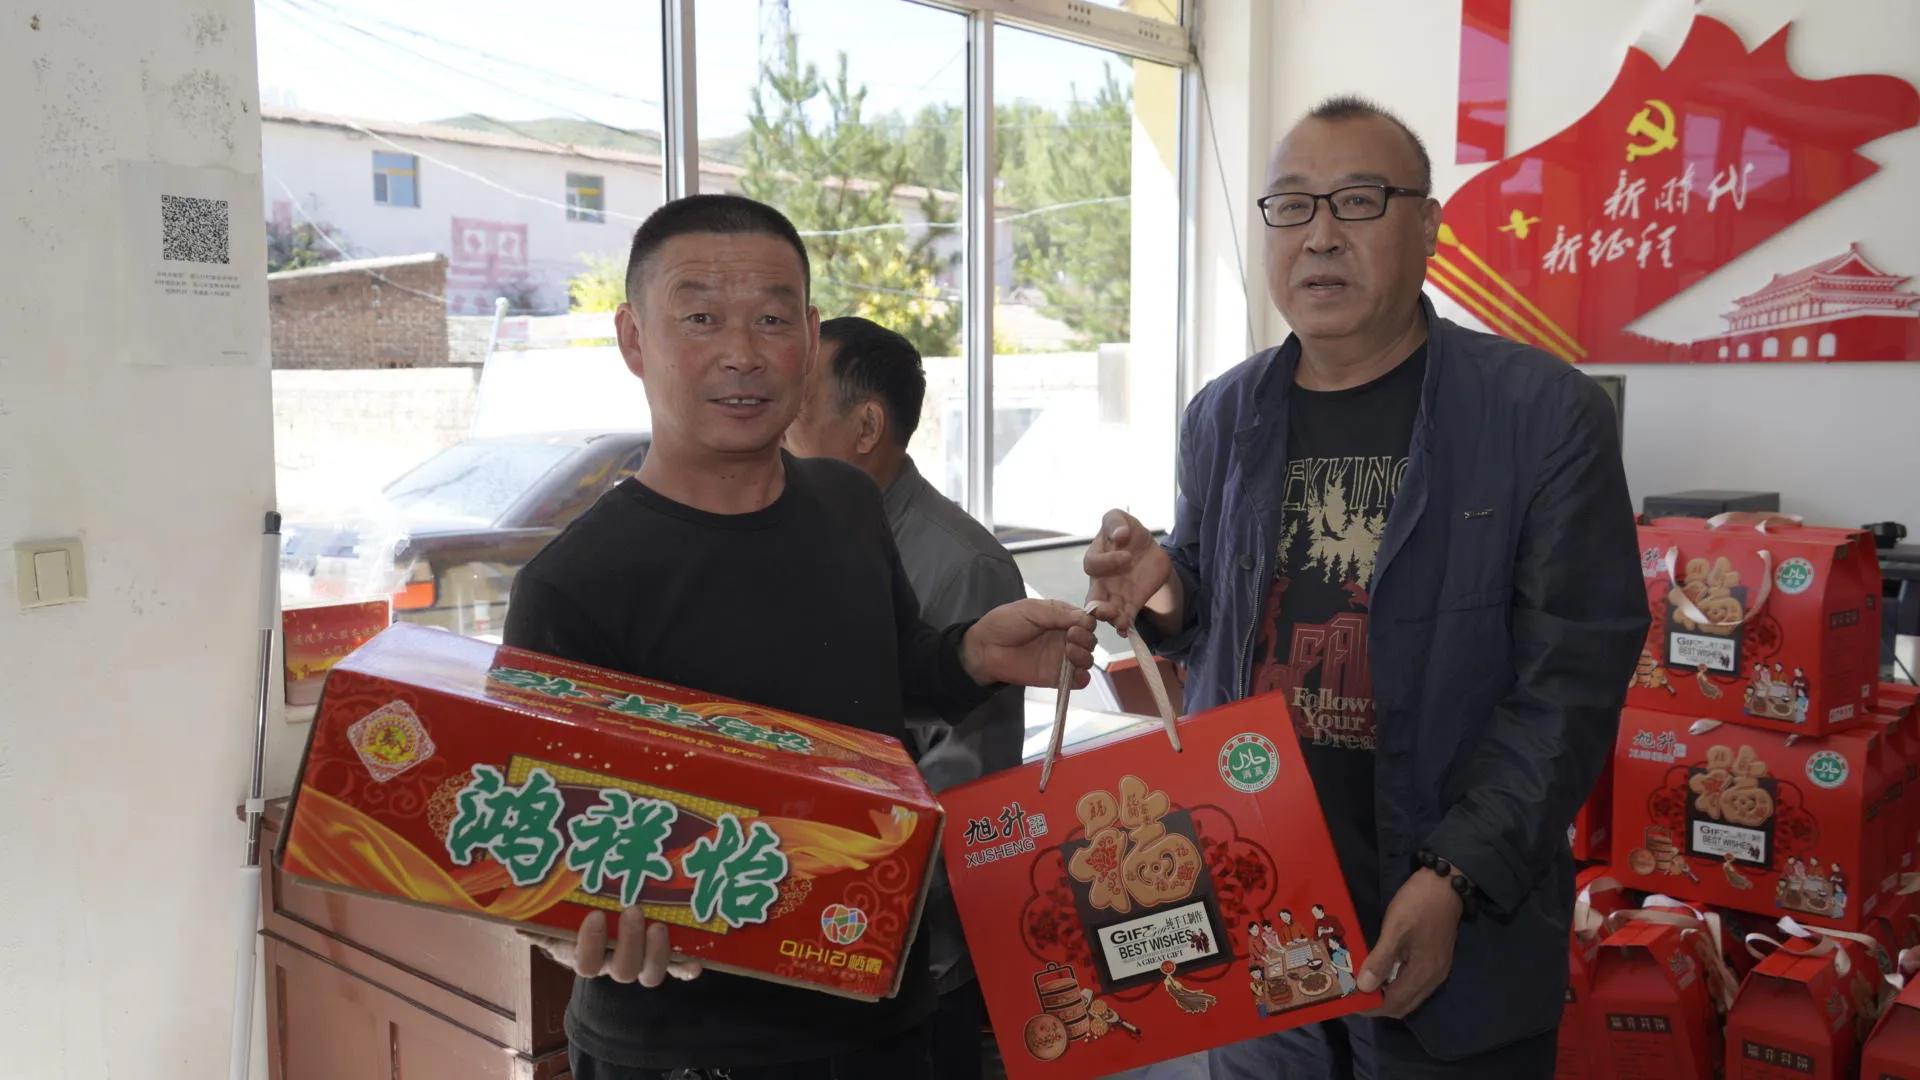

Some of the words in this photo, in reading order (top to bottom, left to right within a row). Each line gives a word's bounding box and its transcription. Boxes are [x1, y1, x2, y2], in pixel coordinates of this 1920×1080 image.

[1542, 222, 1677, 274] 新征程
[1291, 686, 1370, 713] Follow
[1301, 707, 1365, 730] Your
[964, 801, 1026, 846] 旭升
[445, 764, 788, 928] 鸿祥怡
[965, 837, 1035, 868] XUSHENG
[1110, 923, 1154, 945] GIFT
[1118, 941, 1150, 959] BEST
[1148, 929, 1193, 951] WISHES
